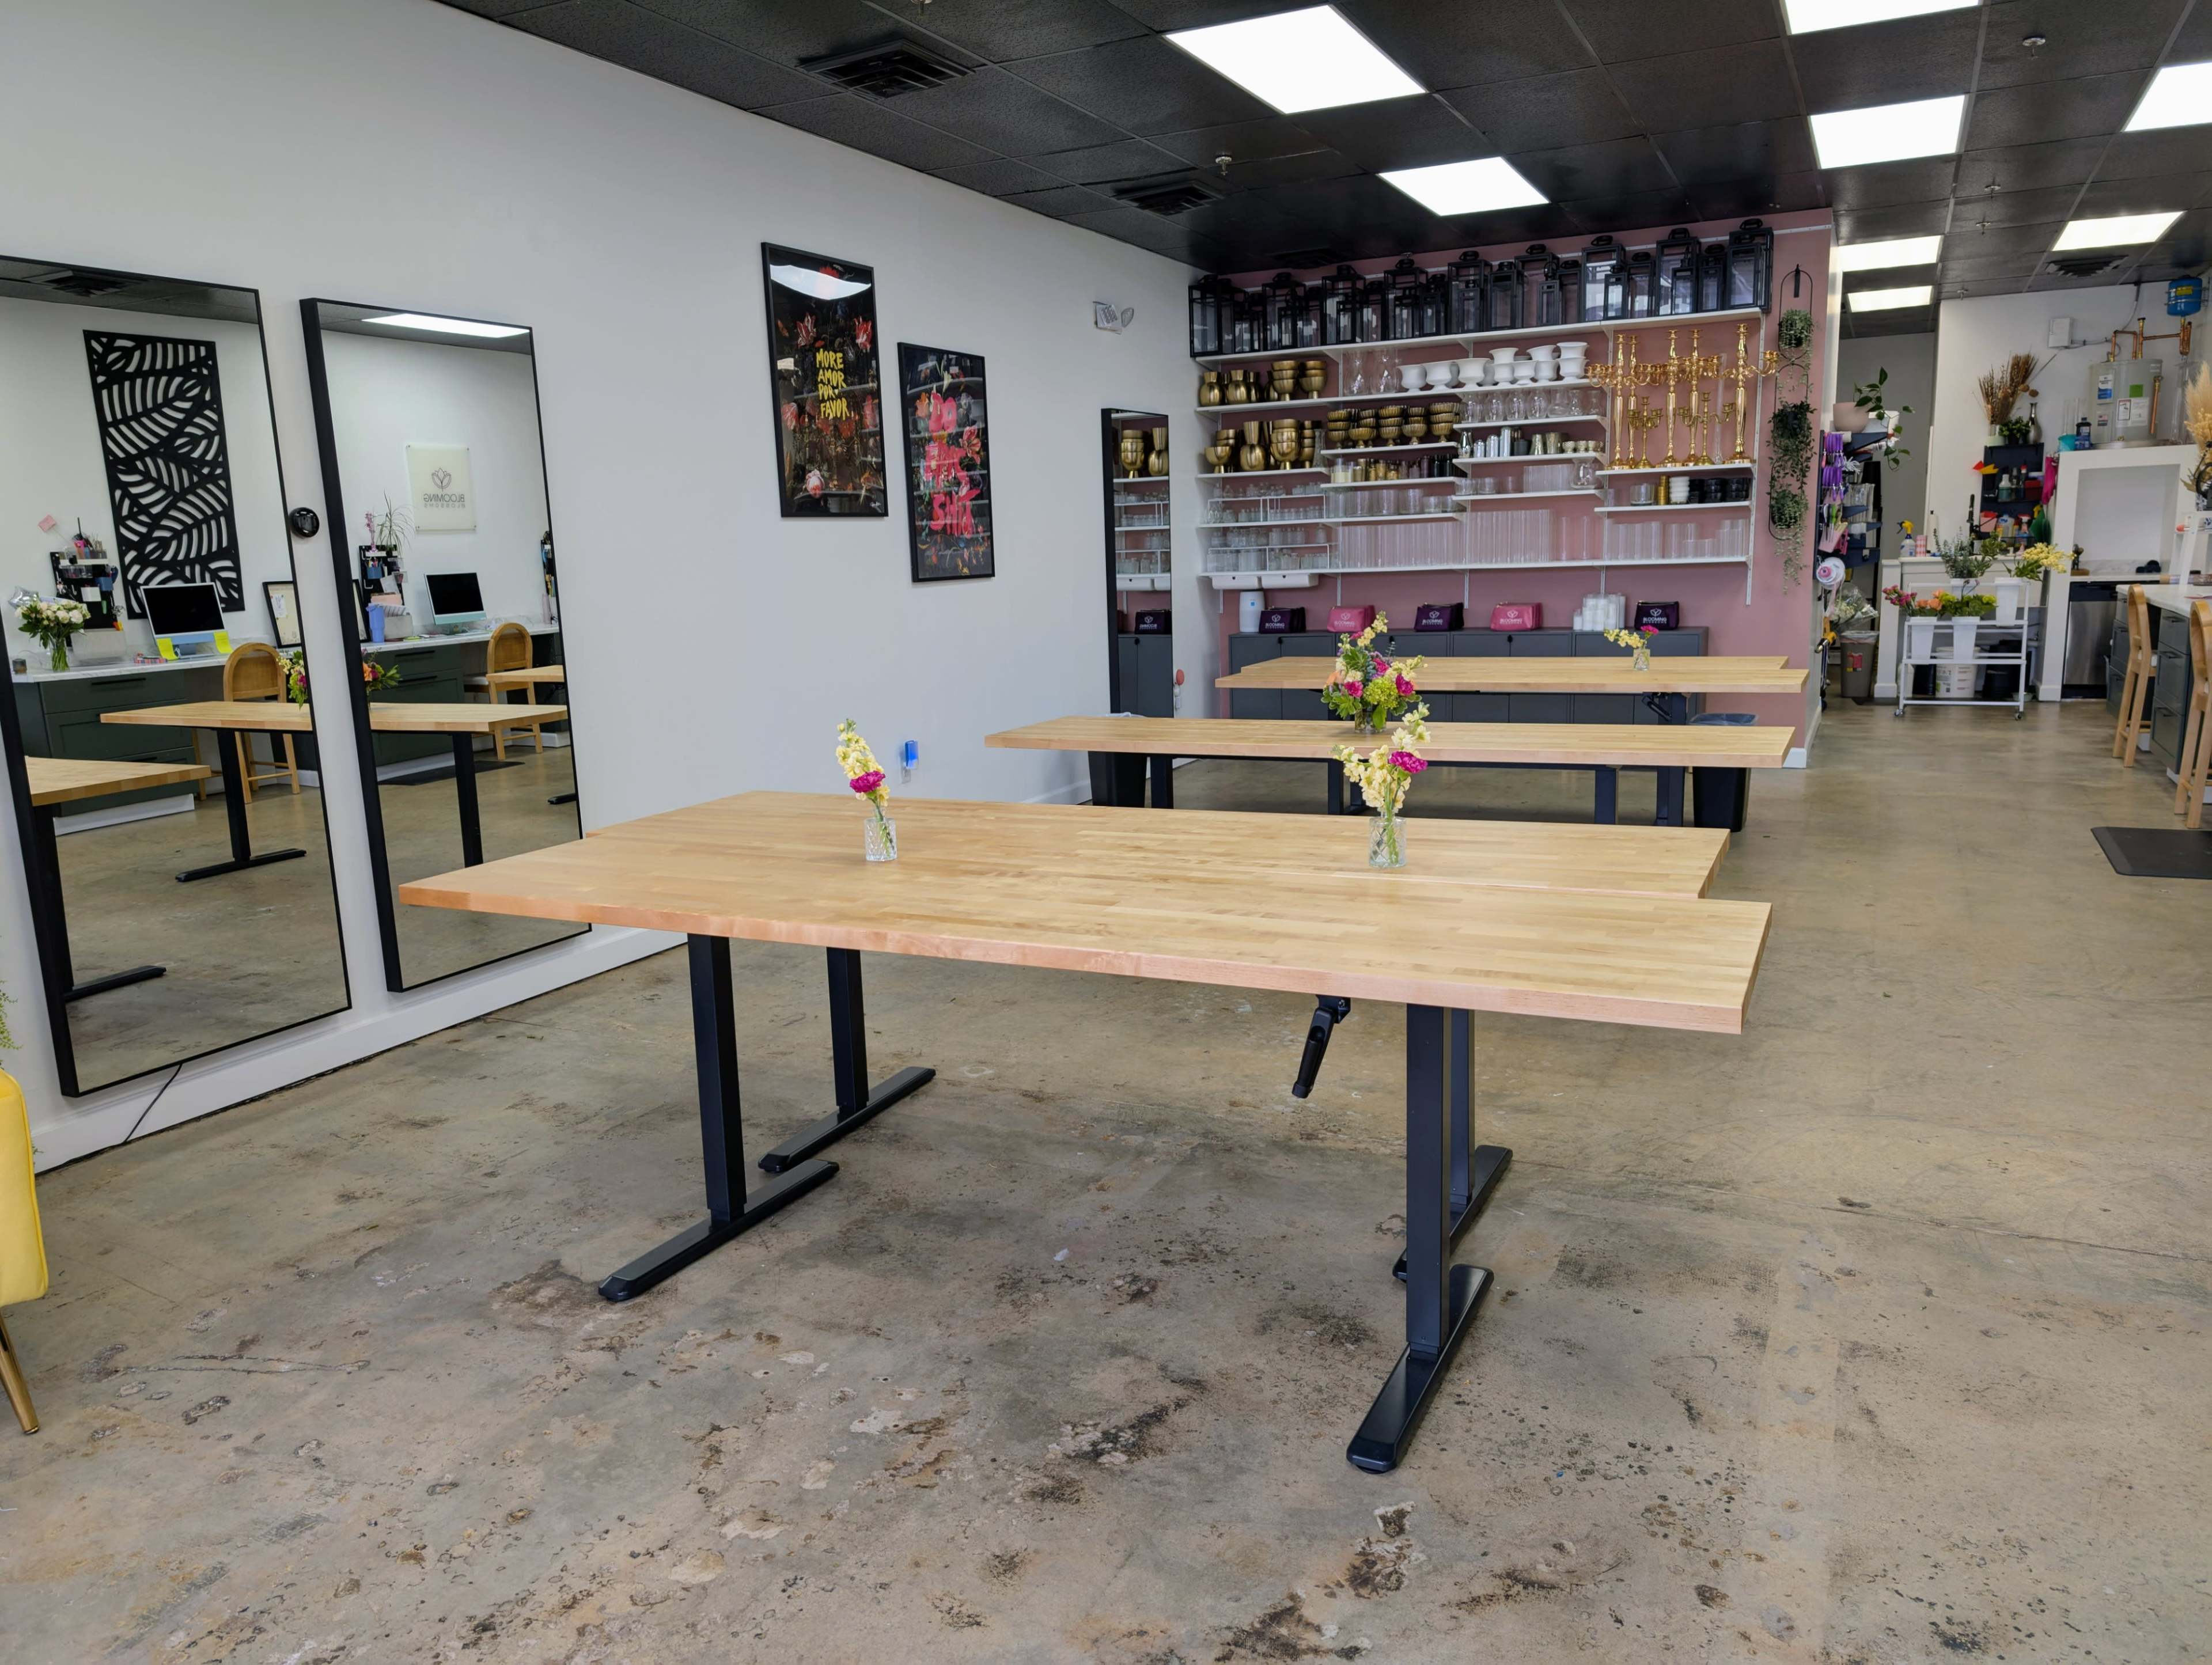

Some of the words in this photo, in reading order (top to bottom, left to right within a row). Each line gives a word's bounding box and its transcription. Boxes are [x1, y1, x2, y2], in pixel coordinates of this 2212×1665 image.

[816, 348, 844, 370] MORE
[818, 369, 847, 390] AMOR
[819, 383, 836, 400] POR
[820, 397, 850, 421] FAVOR
[930, 488, 980, 539] SHIT
